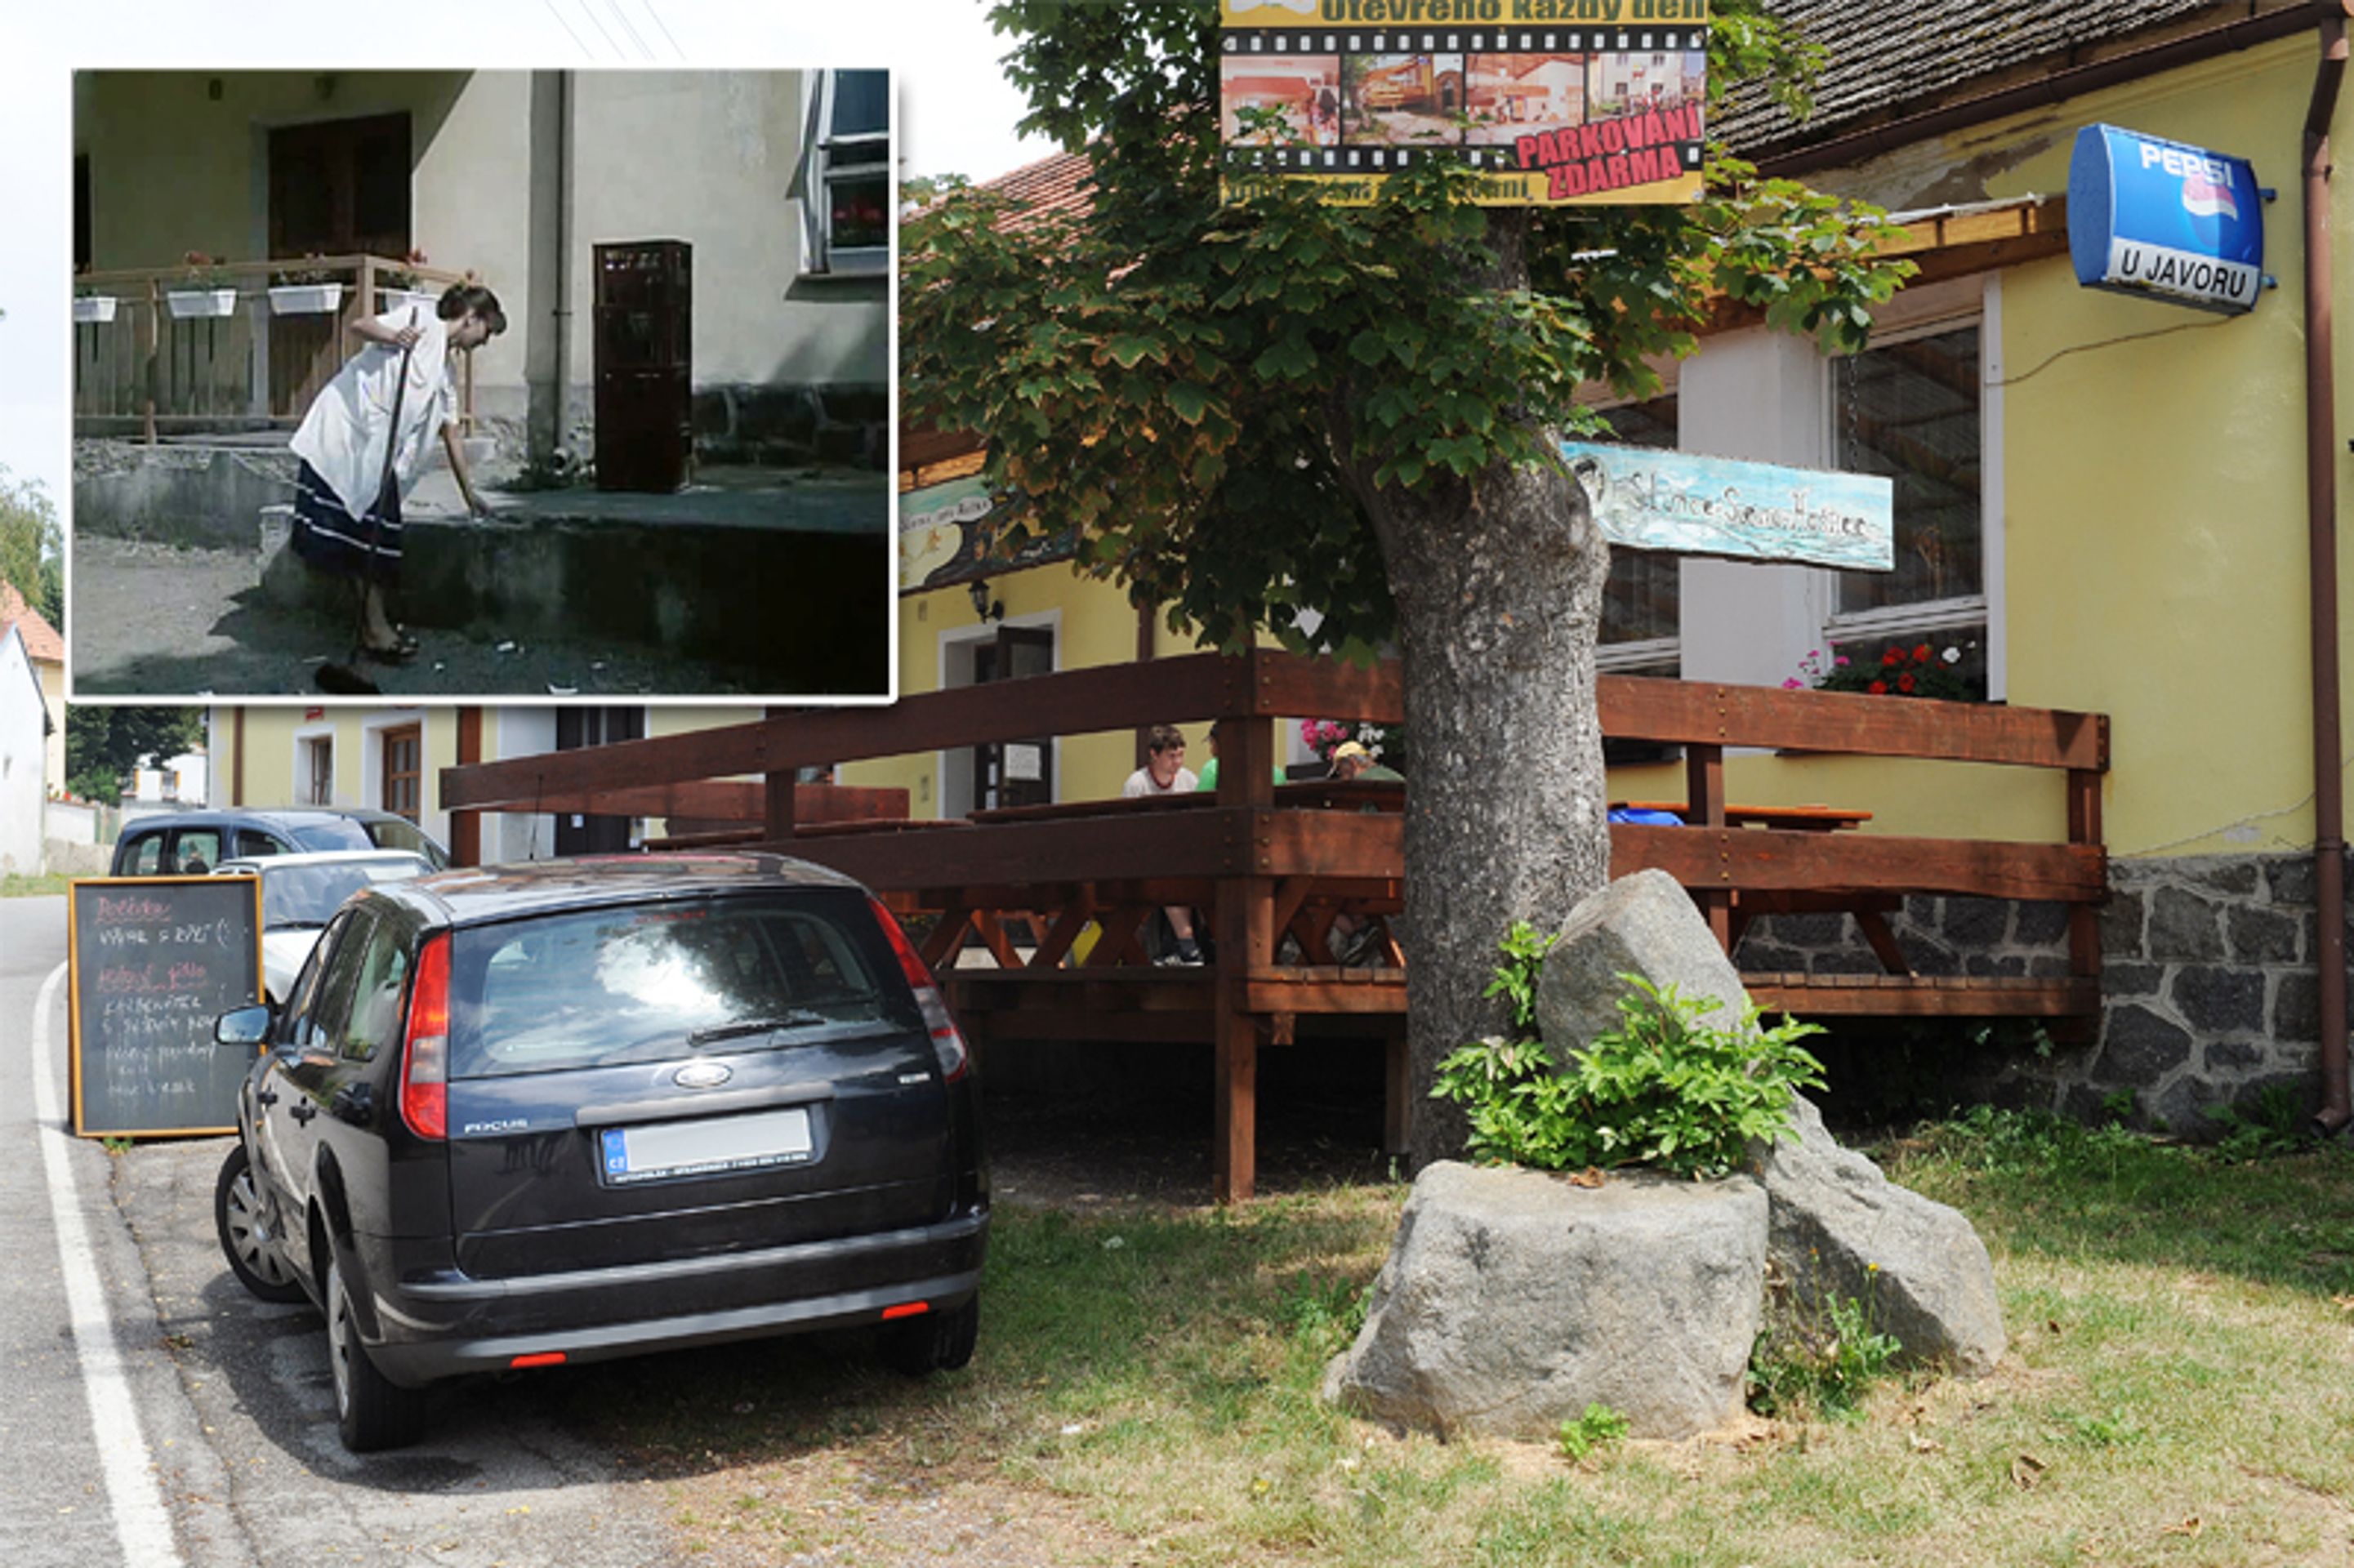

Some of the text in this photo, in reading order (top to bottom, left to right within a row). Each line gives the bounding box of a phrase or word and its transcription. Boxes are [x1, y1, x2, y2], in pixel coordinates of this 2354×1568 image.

[1515, 99, 1701, 169] PARKOVÁNÍ
[1545, 145, 1684, 201] ZDARMA
[2138, 142, 2236, 188] PEPSI
[2120, 248, 2247, 299] U JAVORU
[464, 1117, 528, 1134] FOCUS
